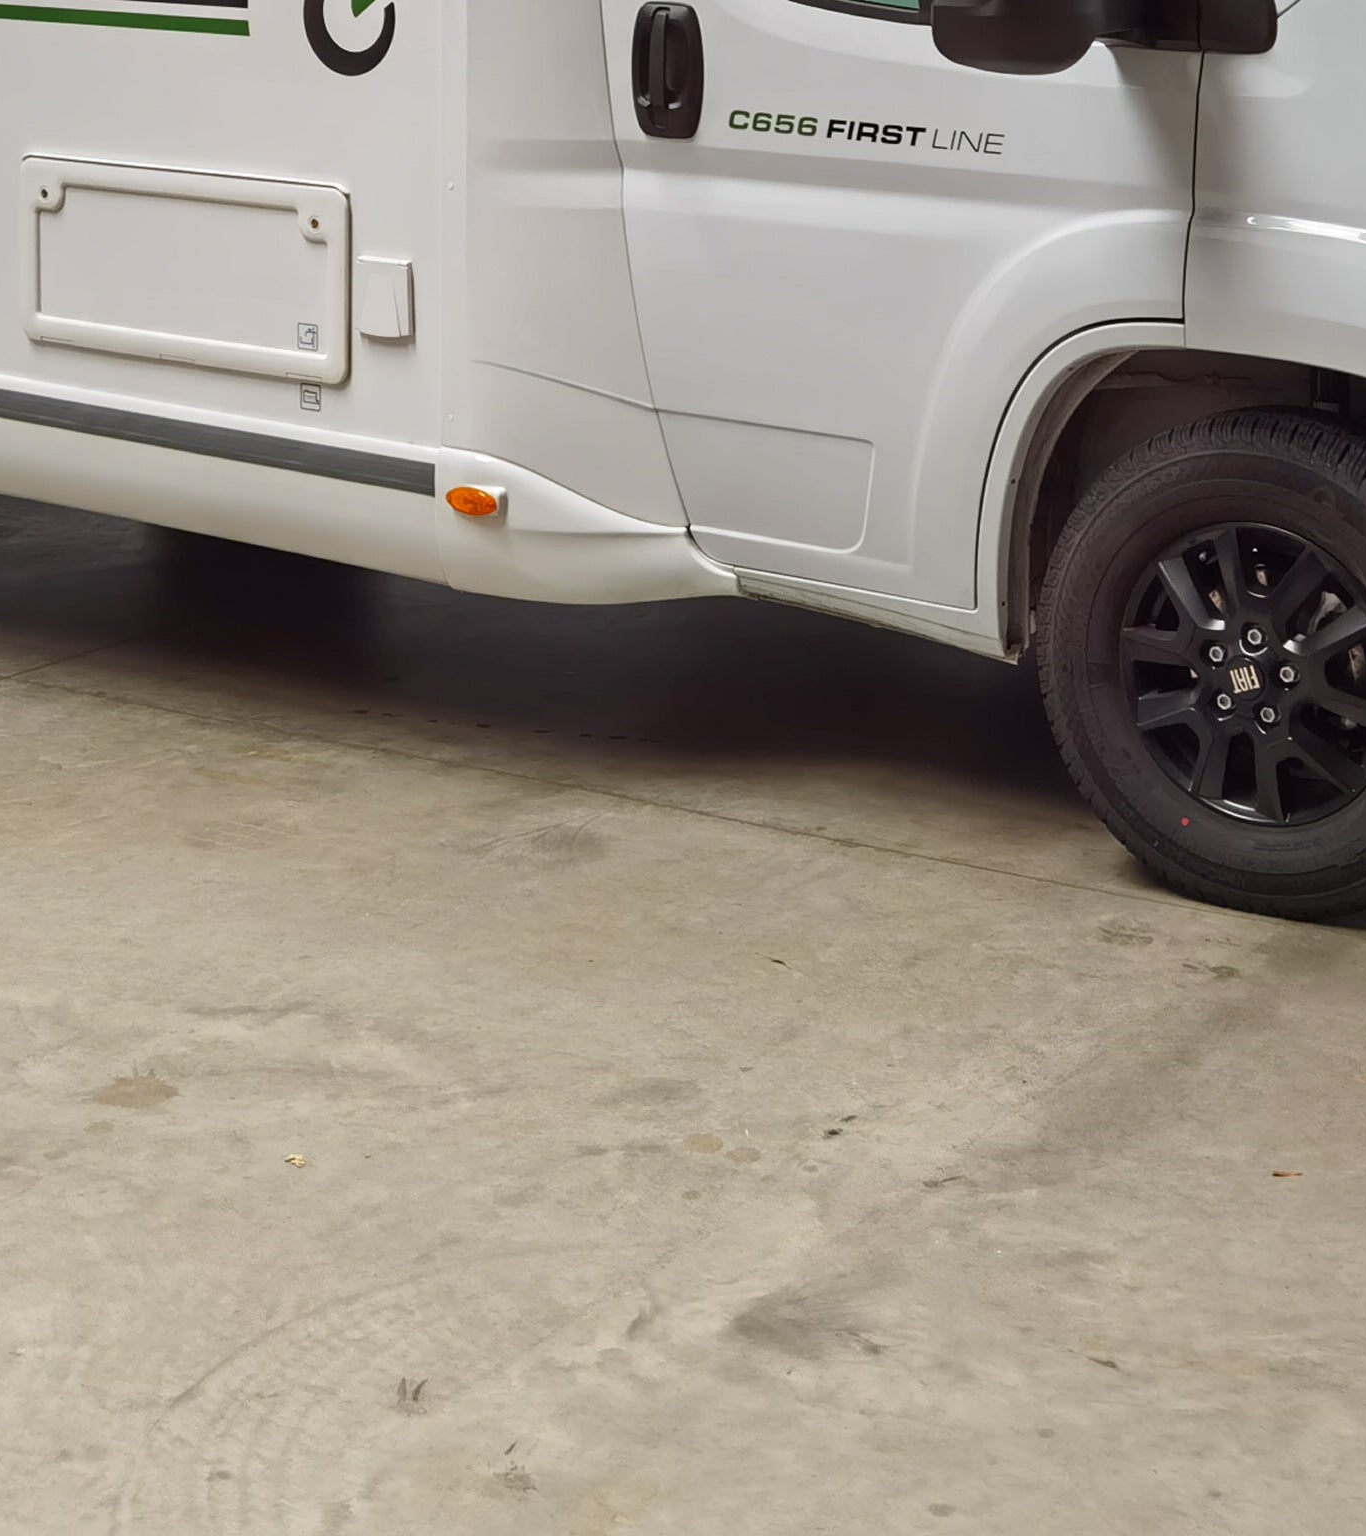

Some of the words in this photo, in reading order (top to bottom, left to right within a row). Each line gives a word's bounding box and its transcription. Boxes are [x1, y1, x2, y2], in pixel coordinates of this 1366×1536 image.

[728, 110, 819, 137] C656
[826, 119, 927, 147] FIRST
[931, 128, 1006, 155] LINE
[1230, 665, 1260, 693] FIAT
